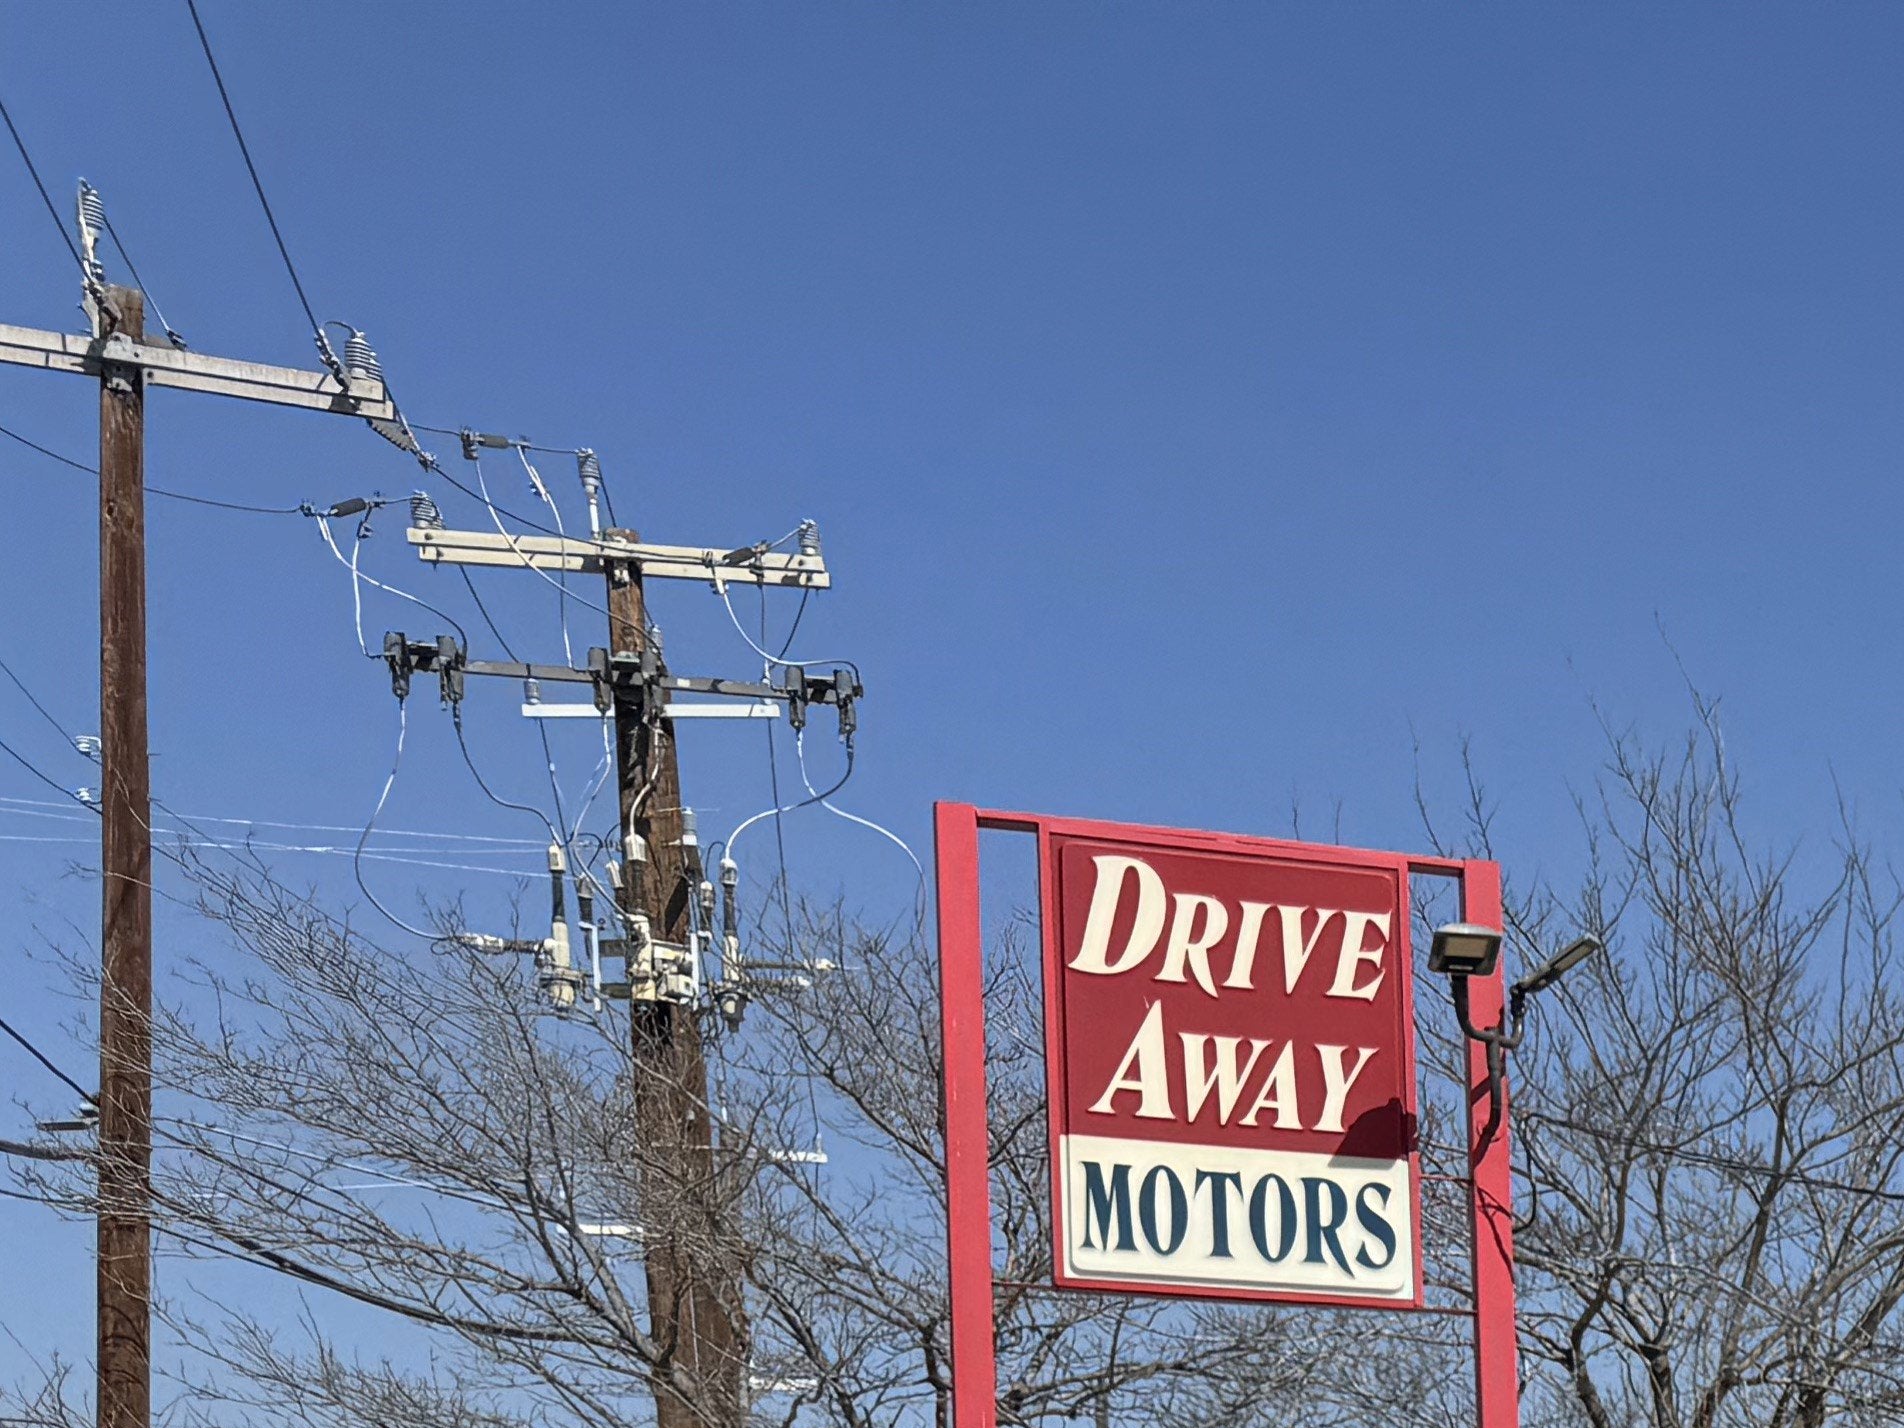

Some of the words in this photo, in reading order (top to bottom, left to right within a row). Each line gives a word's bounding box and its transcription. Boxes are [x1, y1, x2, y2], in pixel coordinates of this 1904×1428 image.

[1067, 854, 1391, 1001] DRIVE
[1087, 999, 1379, 1133] AWAY
[1080, 1161, 1398, 1278] MOTORS
